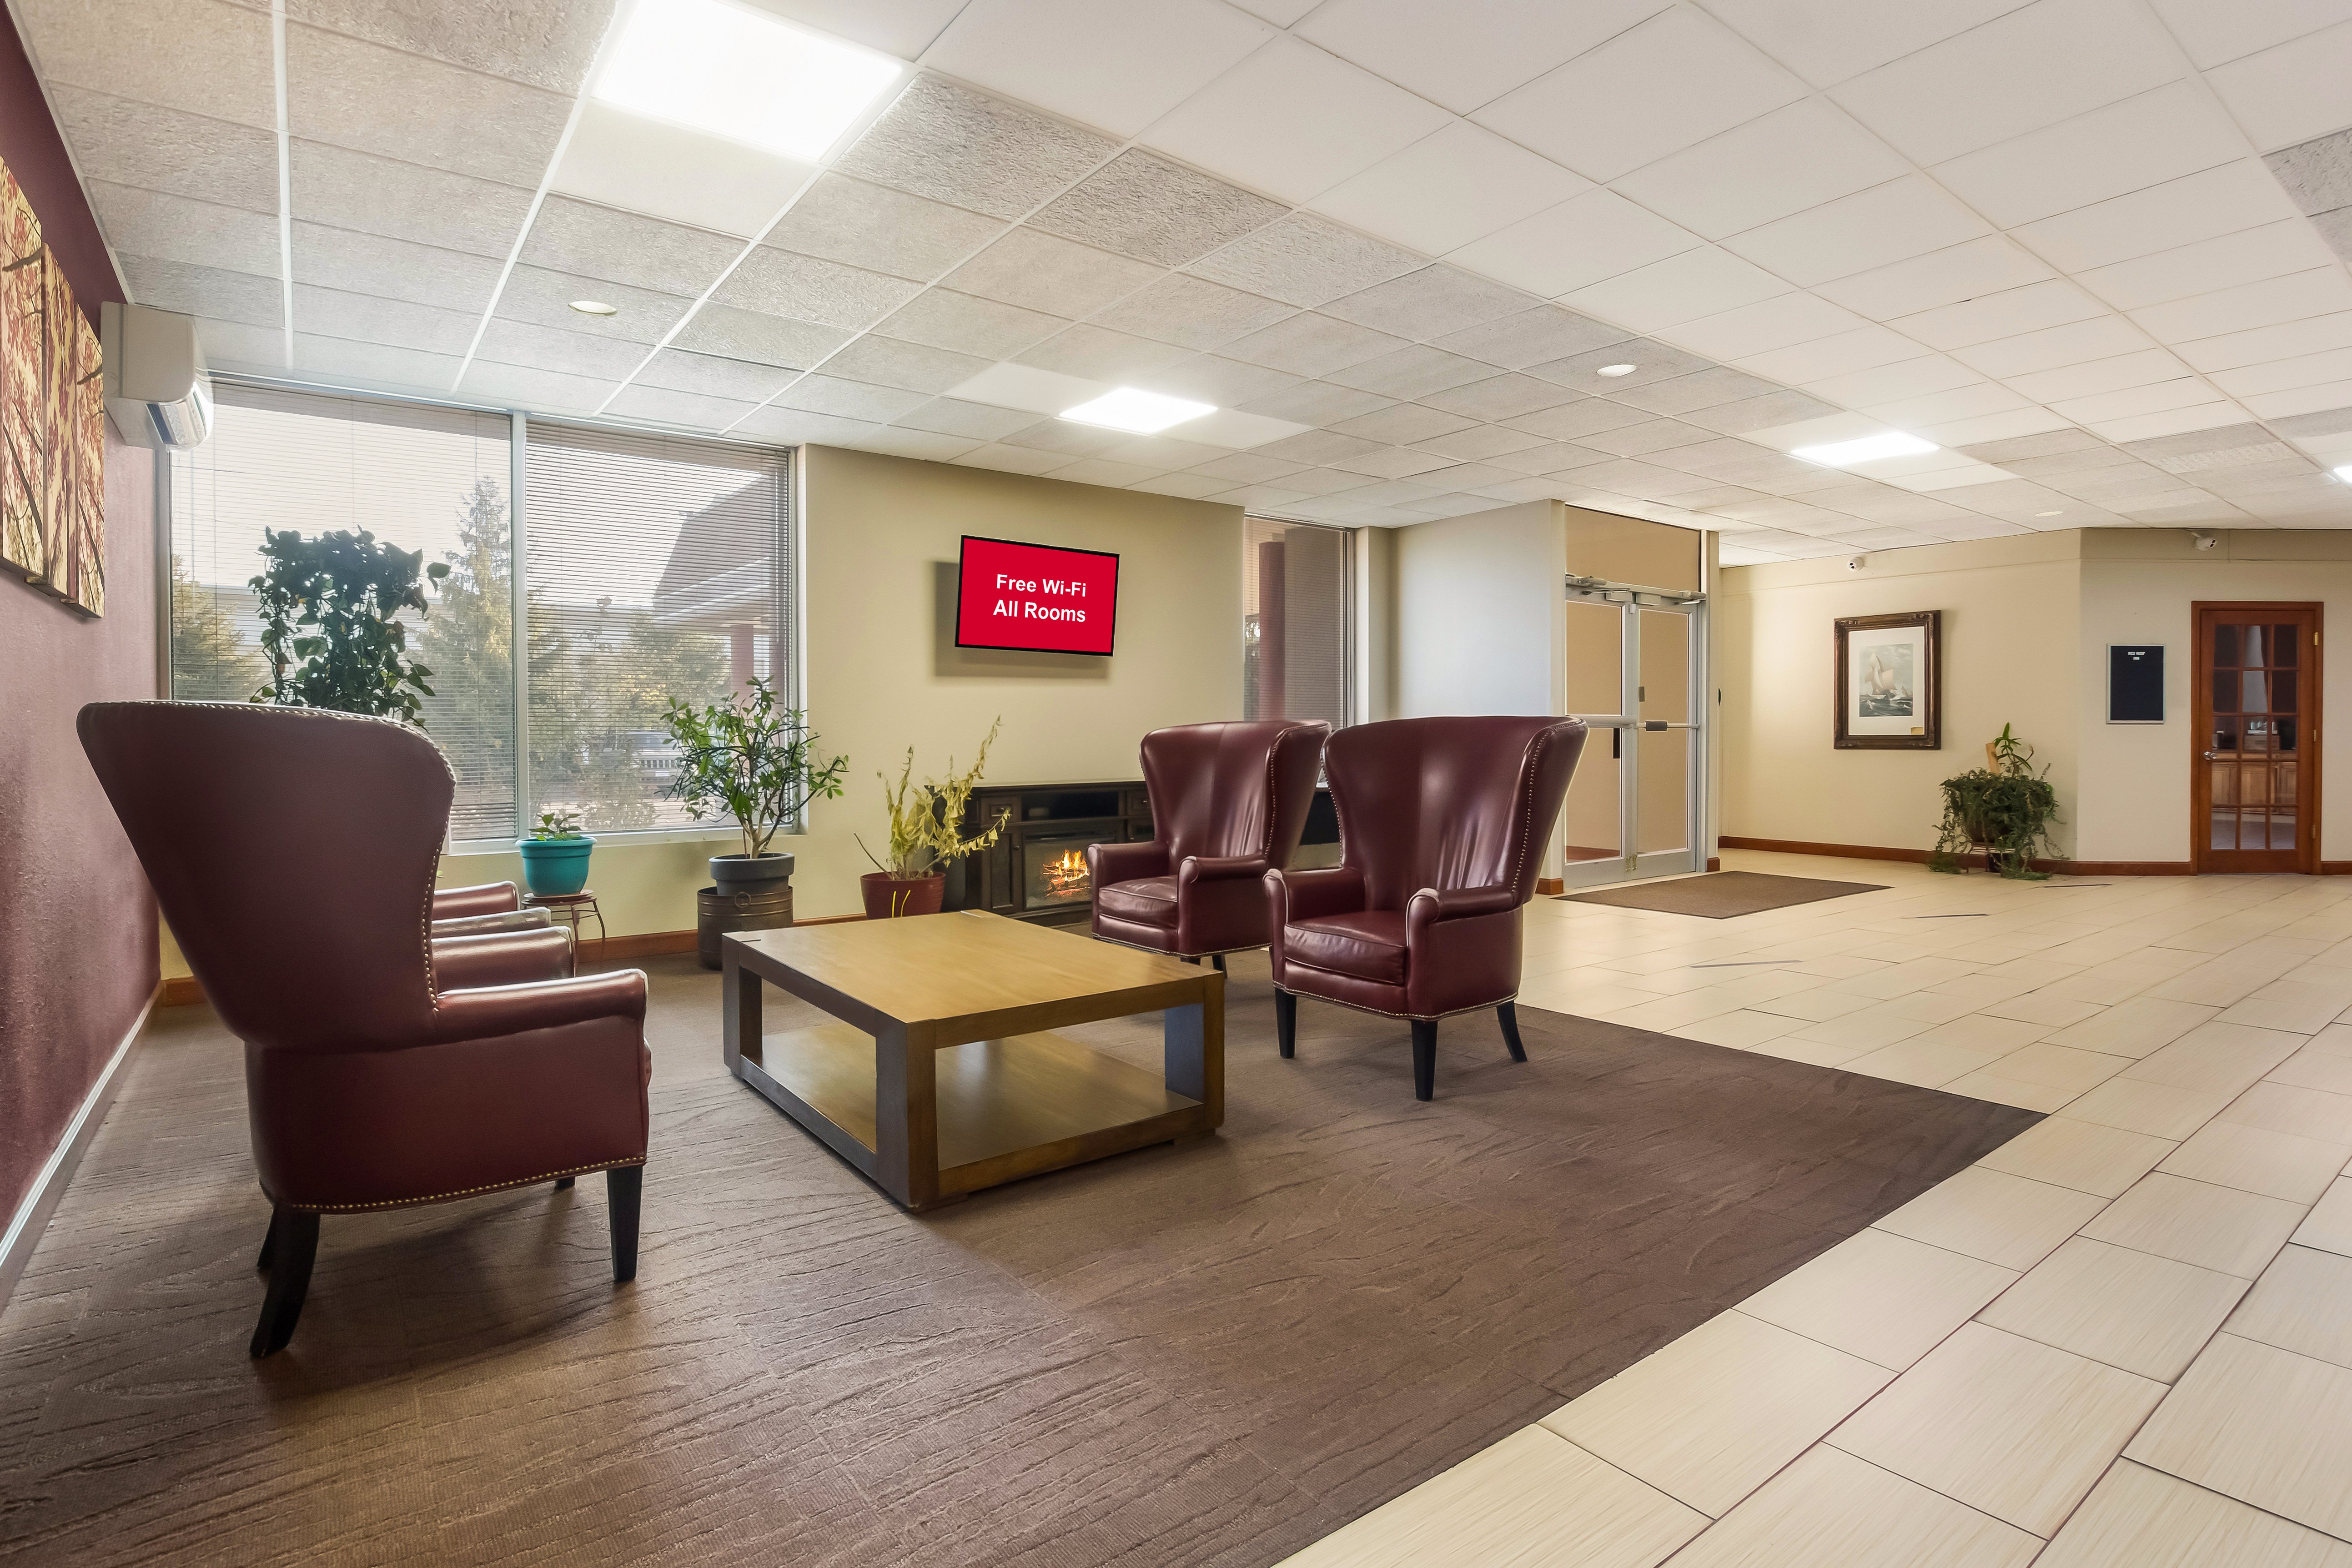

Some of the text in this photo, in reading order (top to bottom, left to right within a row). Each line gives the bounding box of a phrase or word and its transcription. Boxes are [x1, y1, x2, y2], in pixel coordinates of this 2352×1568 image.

[996, 574, 1086, 597] Free Wi-Fi
[993, 599, 1086, 623] All Rooms
